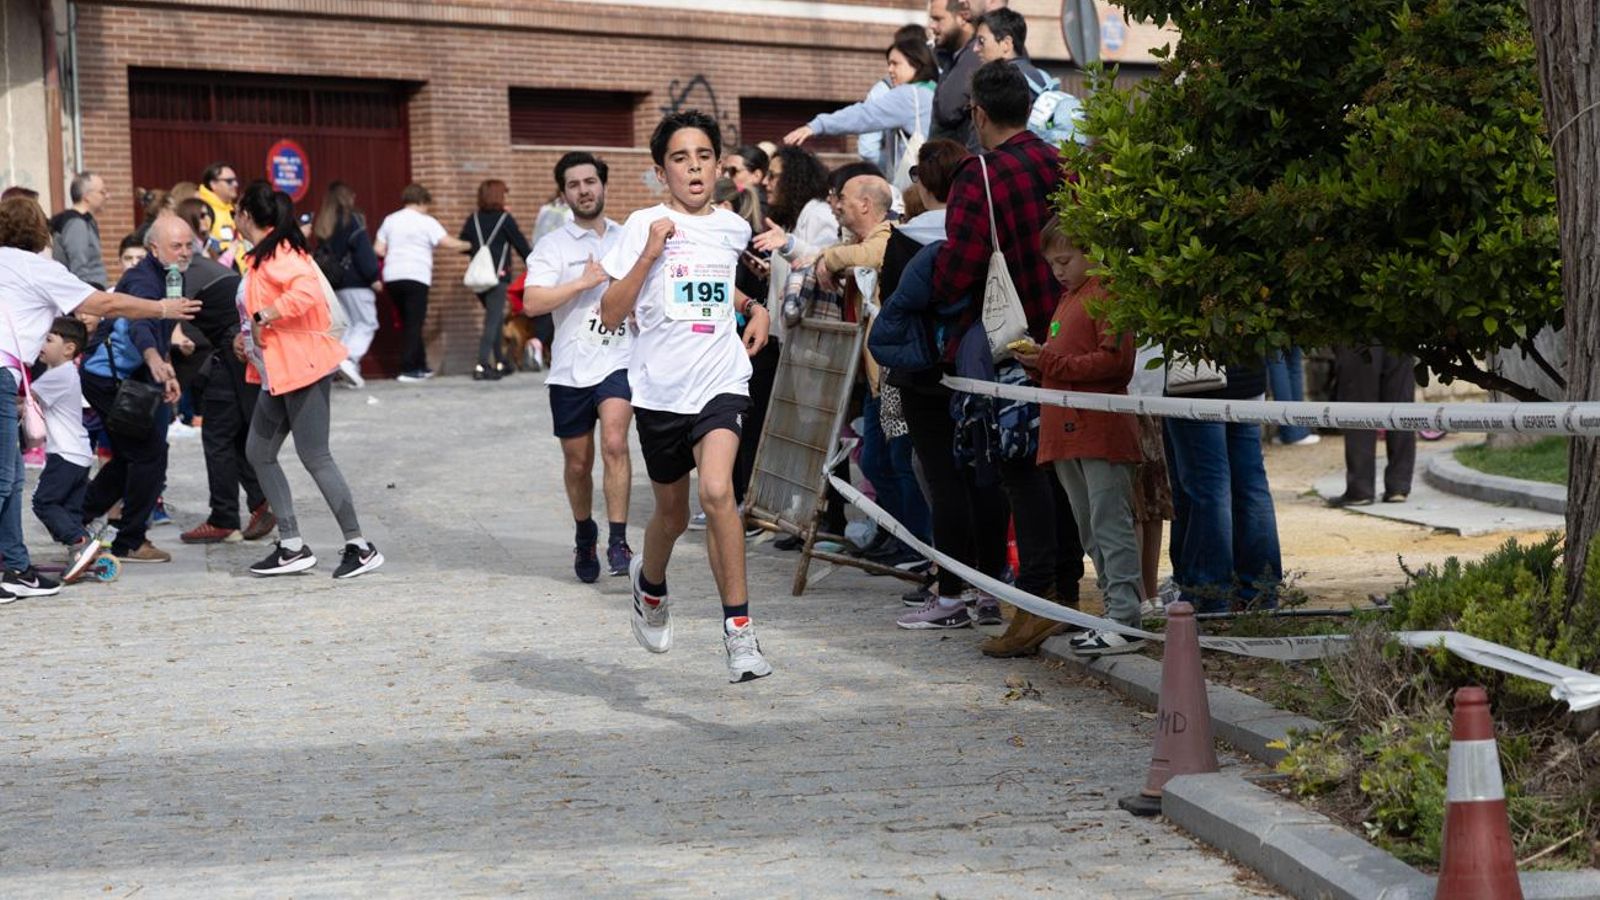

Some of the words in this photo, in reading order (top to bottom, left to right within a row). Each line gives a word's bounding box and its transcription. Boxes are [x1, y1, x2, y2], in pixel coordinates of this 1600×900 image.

[682, 281, 725, 303] 195
[1399, 416, 1430, 429] DEPORTES
[1522, 415, 1557, 429] DEPORTES
